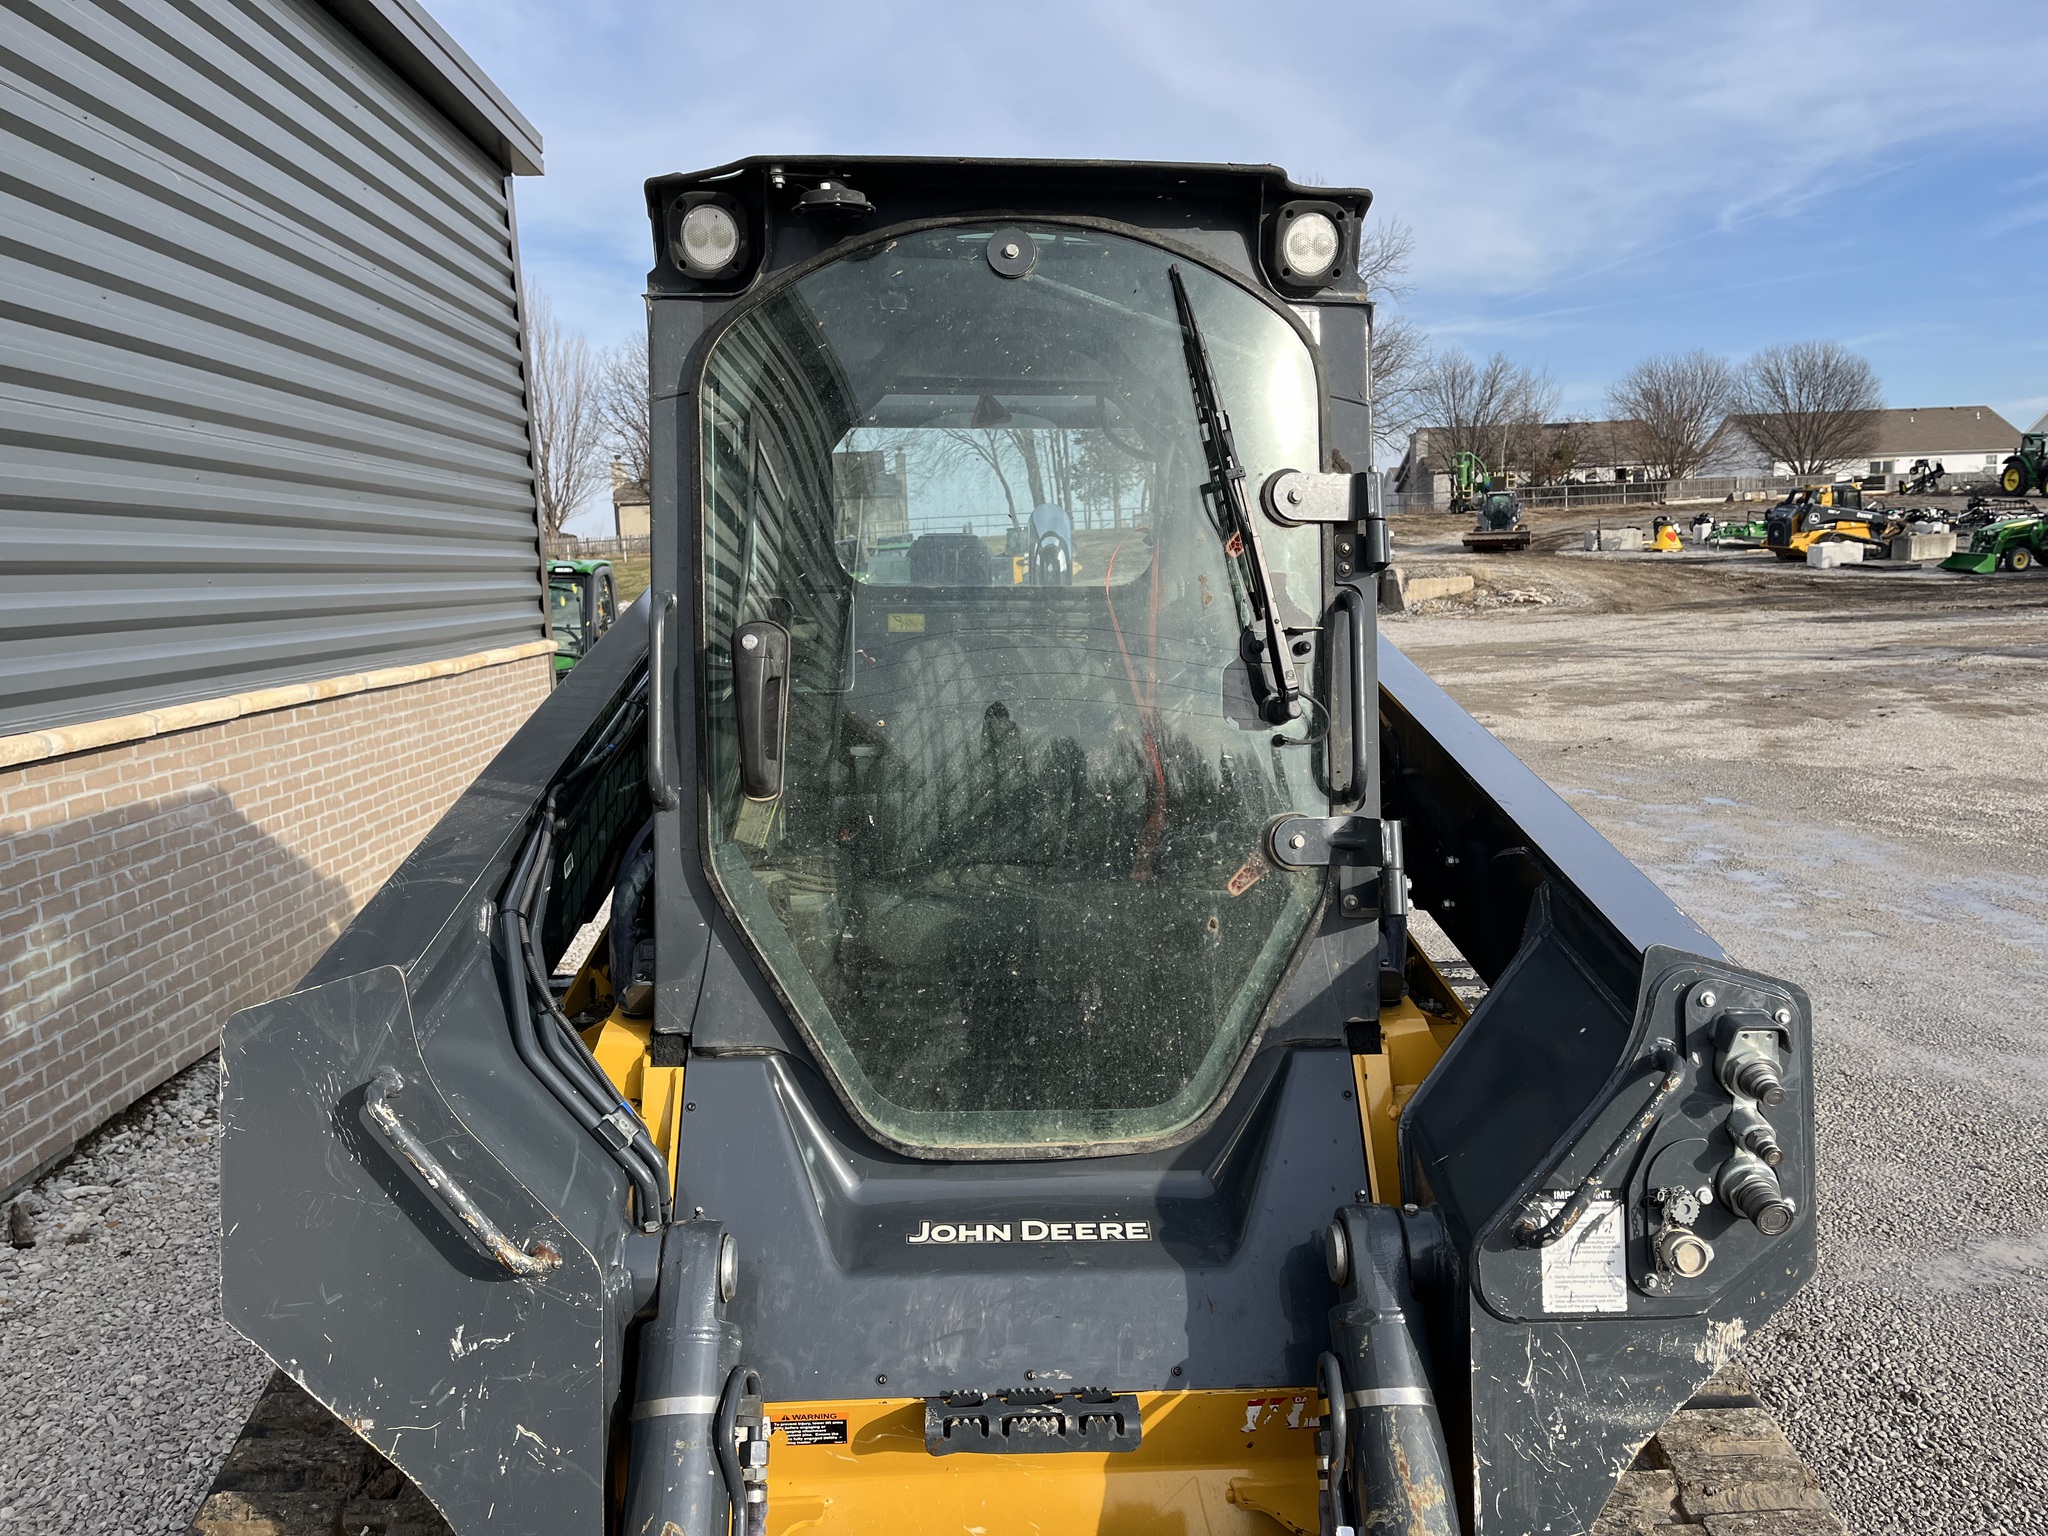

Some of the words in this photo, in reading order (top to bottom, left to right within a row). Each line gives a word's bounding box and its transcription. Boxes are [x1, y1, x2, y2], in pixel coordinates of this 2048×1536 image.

[908, 1221, 1012, 1243] JOHN
[1021, 1219, 1149, 1241] DEERE
[791, 1413, 837, 1421] WARNING
